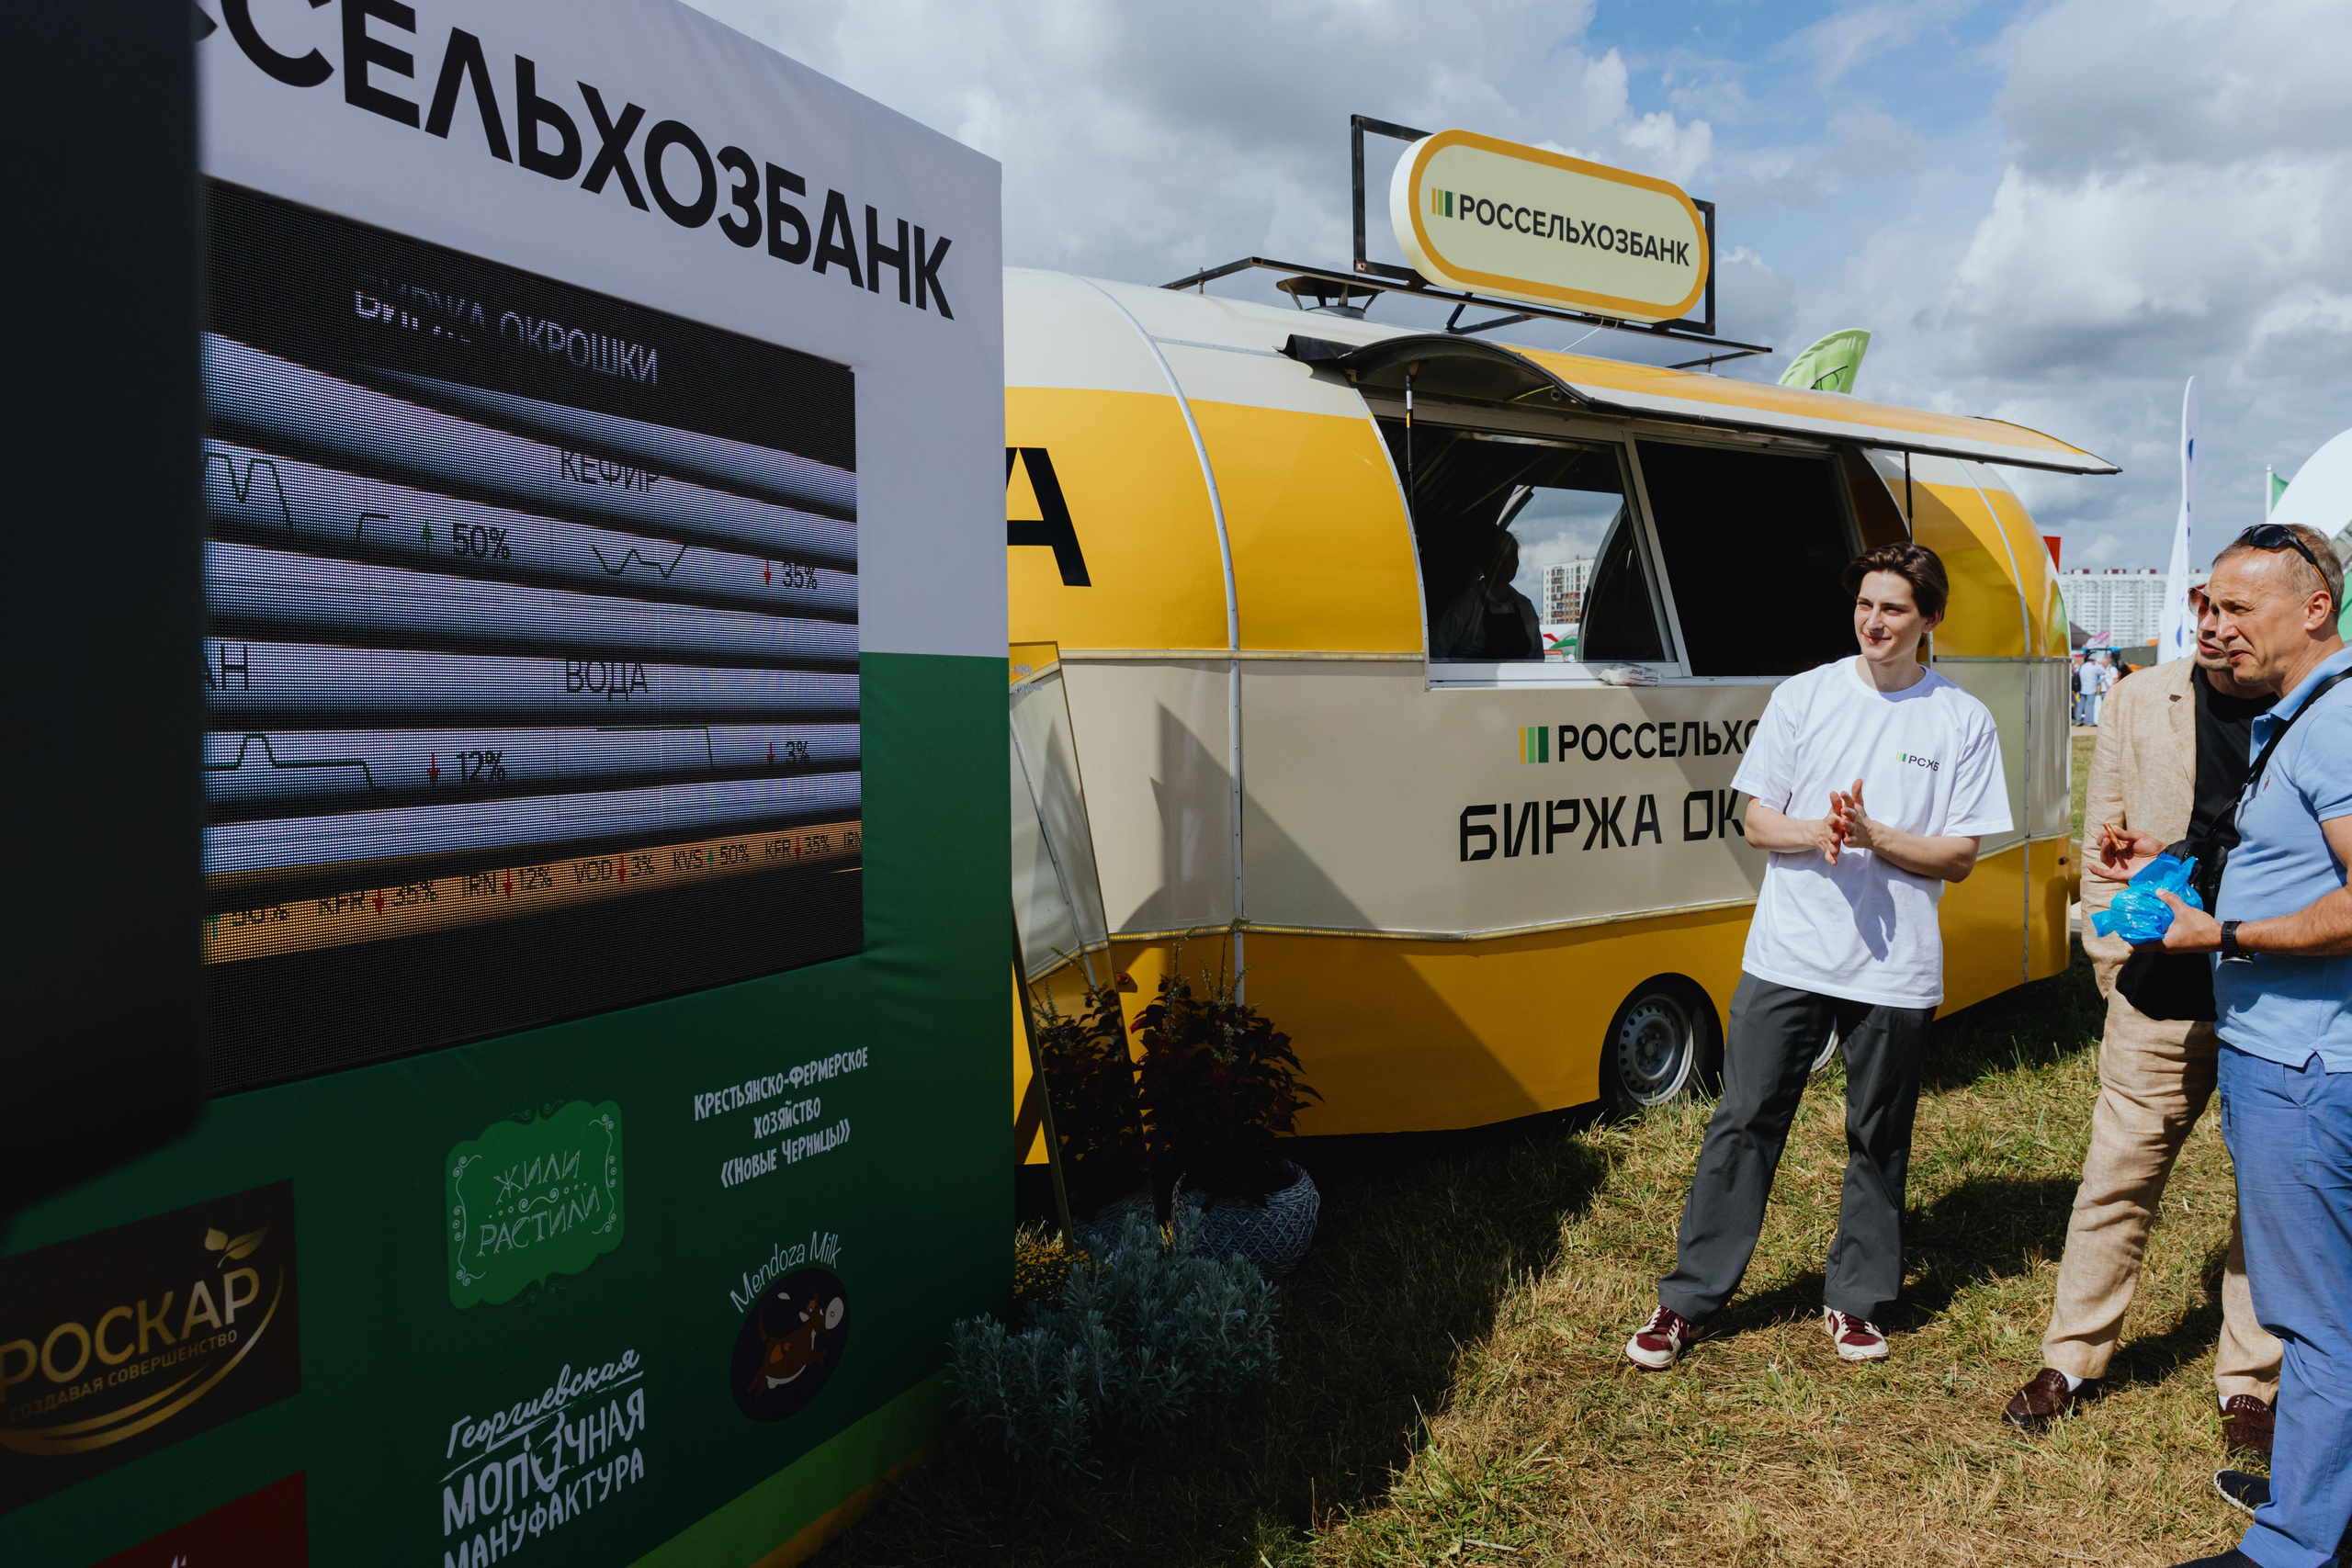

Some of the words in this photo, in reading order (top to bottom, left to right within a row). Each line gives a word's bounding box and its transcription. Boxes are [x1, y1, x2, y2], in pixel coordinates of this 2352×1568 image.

[192, 0, 955, 321] СЕЛЬХОЗБАНК
[1459, 193, 1690, 267] РОССЕЛЬХОЗБАНК
[501, 310, 659, 385] ОКРОШКИ
[561, 447, 661, 493] КЕФИР
[453, 523, 512, 559] 50%
[782, 562, 818, 590] 35%
[566, 660, 649, 703] ВОДА
[457, 750, 506, 782] 12%
[786, 740, 810, 763] 3%
[1908, 754, 1940, 773] РСХБ
[518, 865, 552, 890] 12%
[573, 858, 613, 883] VOD
[630, 853, 654, 876] 3%
[673, 848, 703, 871] KVS
[718, 843, 750, 865] 50%
[763, 838, 791, 861] KFR
[804, 833, 829, 855] 35%
[1459, 794, 1663, 863] БИРЖА
[694, 1045, 869, 1122] КРЕСТЬЯНСКО-ФЕРМЕРСКОЕ
[752, 1096, 822, 1139] ХОЗЯЙСТВО
[492, 1149, 582, 1206] ЖИЛИ
[476, 1185, 601, 1258] РАСТИЛИ
[729, 1243, 806, 1314] Mendoza
[809, 1231, 842, 1269] Milk
[0, 1267, 260, 1404] РОСКАР
[8, 1380, 104, 1423] СОЗДАВАЯ
[107, 1329, 238, 1387] СОВЕРШЕНСТВО
[446, 1348, 641, 1459] Георгиевская
[444, 1447, 645, 1568] МАНУФАКТУРА
